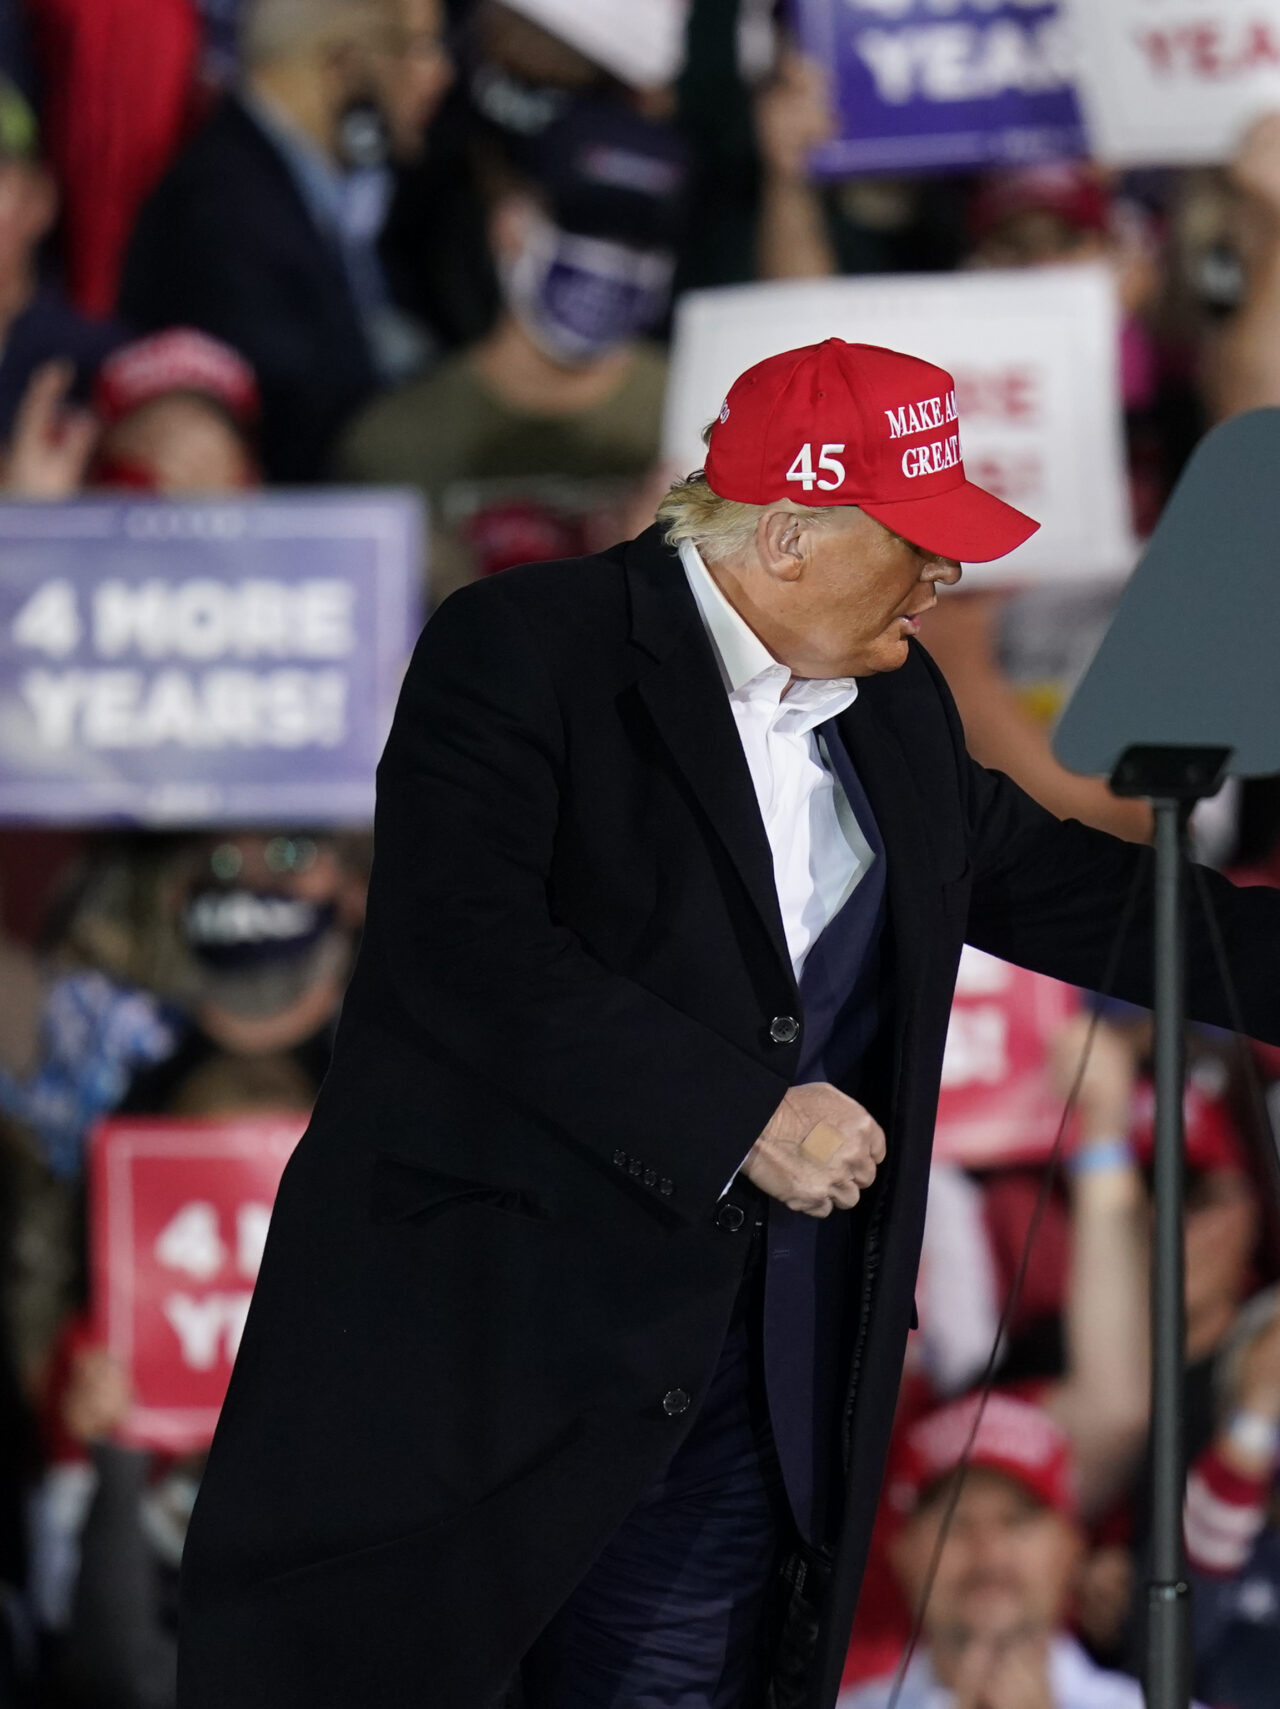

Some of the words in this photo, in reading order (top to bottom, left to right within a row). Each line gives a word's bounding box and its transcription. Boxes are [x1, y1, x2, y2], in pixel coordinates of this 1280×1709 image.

[885, 397, 944, 439] MAKE
[785, 442, 846, 492] 45
[901, 436, 959, 479] GREAT
[10, 575, 82, 662] 4
[91, 575, 358, 662] MORE
[20, 665, 350, 752] YEARS!
[152, 1198, 226, 1284] 4
